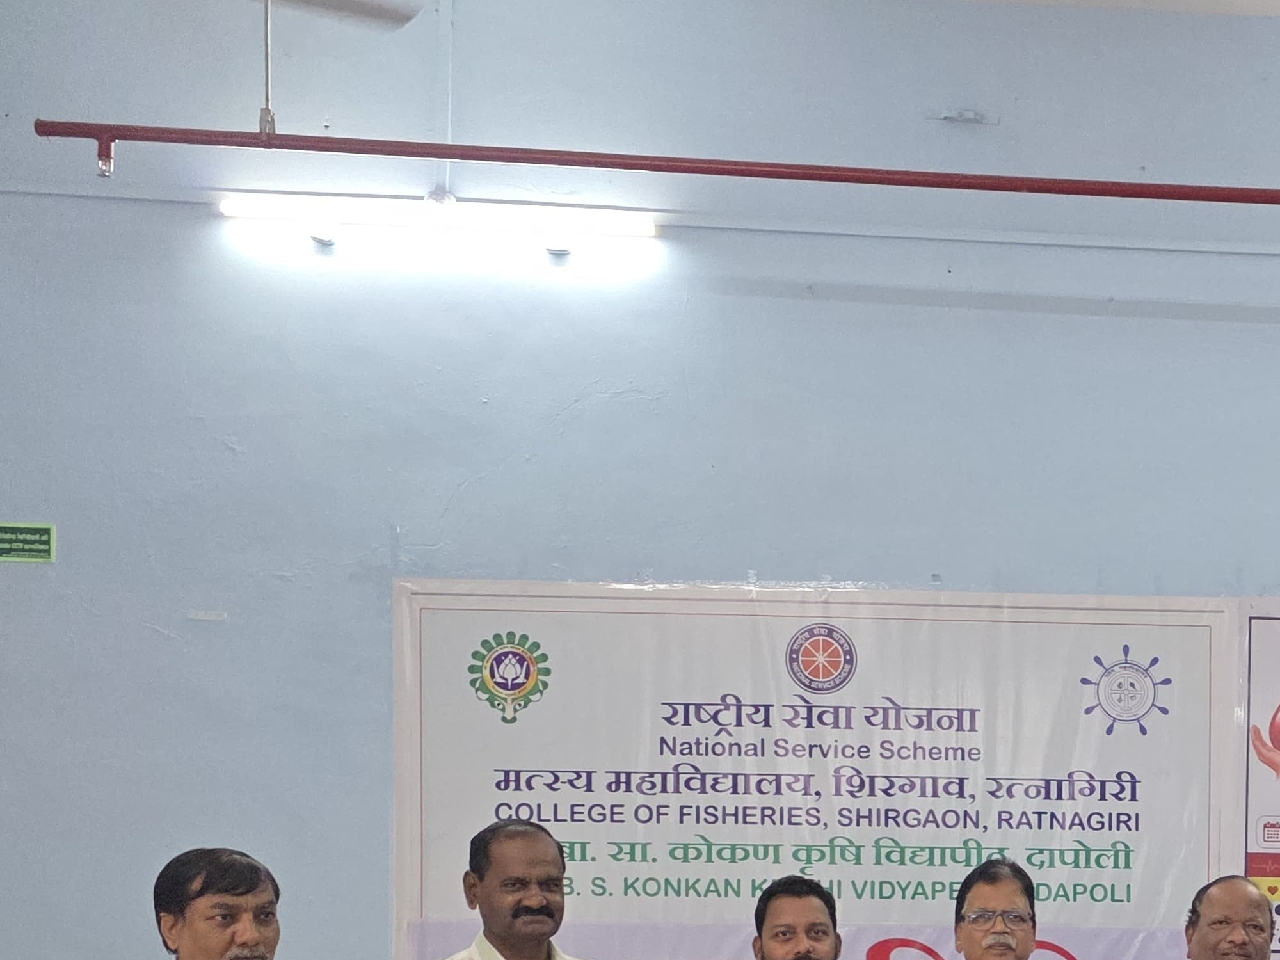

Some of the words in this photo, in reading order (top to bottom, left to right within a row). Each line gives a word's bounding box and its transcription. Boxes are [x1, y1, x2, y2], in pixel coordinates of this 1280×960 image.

[660, 693, 774, 737] राष्ट्रीय
[782, 694, 856, 730] सेवा
[863, 696, 980, 733] योजना
[659, 736, 765, 757] National
[773, 738, 870, 759] Service
[879, 740, 981, 761] Scheme
[493, 769, 597, 793] मत्स्य
[604, 763, 822, 801] महाविद्यालय,
[831, 765, 976, 803] शिरगाव,
[985, 770, 1142, 802] रत्नागिरी
[494, 803, 625, 824] COLLEGE
[634, 804, 669, 824] OF
[679, 805, 829, 830] FISHERIES,
[837, 807, 988, 833] SHIRGAON,
[997, 811, 1141, 832] RATNAGIRI
[607, 842, 658, 863] सा.
[668, 834, 783, 864] कोकण
[792, 836, 865, 876] कृषि
[1025, 840, 1135, 870] दापोली
[591, 877, 613, 897] S.
[624, 877, 741, 898] KONKAN
[851, 880, 959, 901] VIDYAPE
[1036, 883, 1132, 903] DAPOLI
